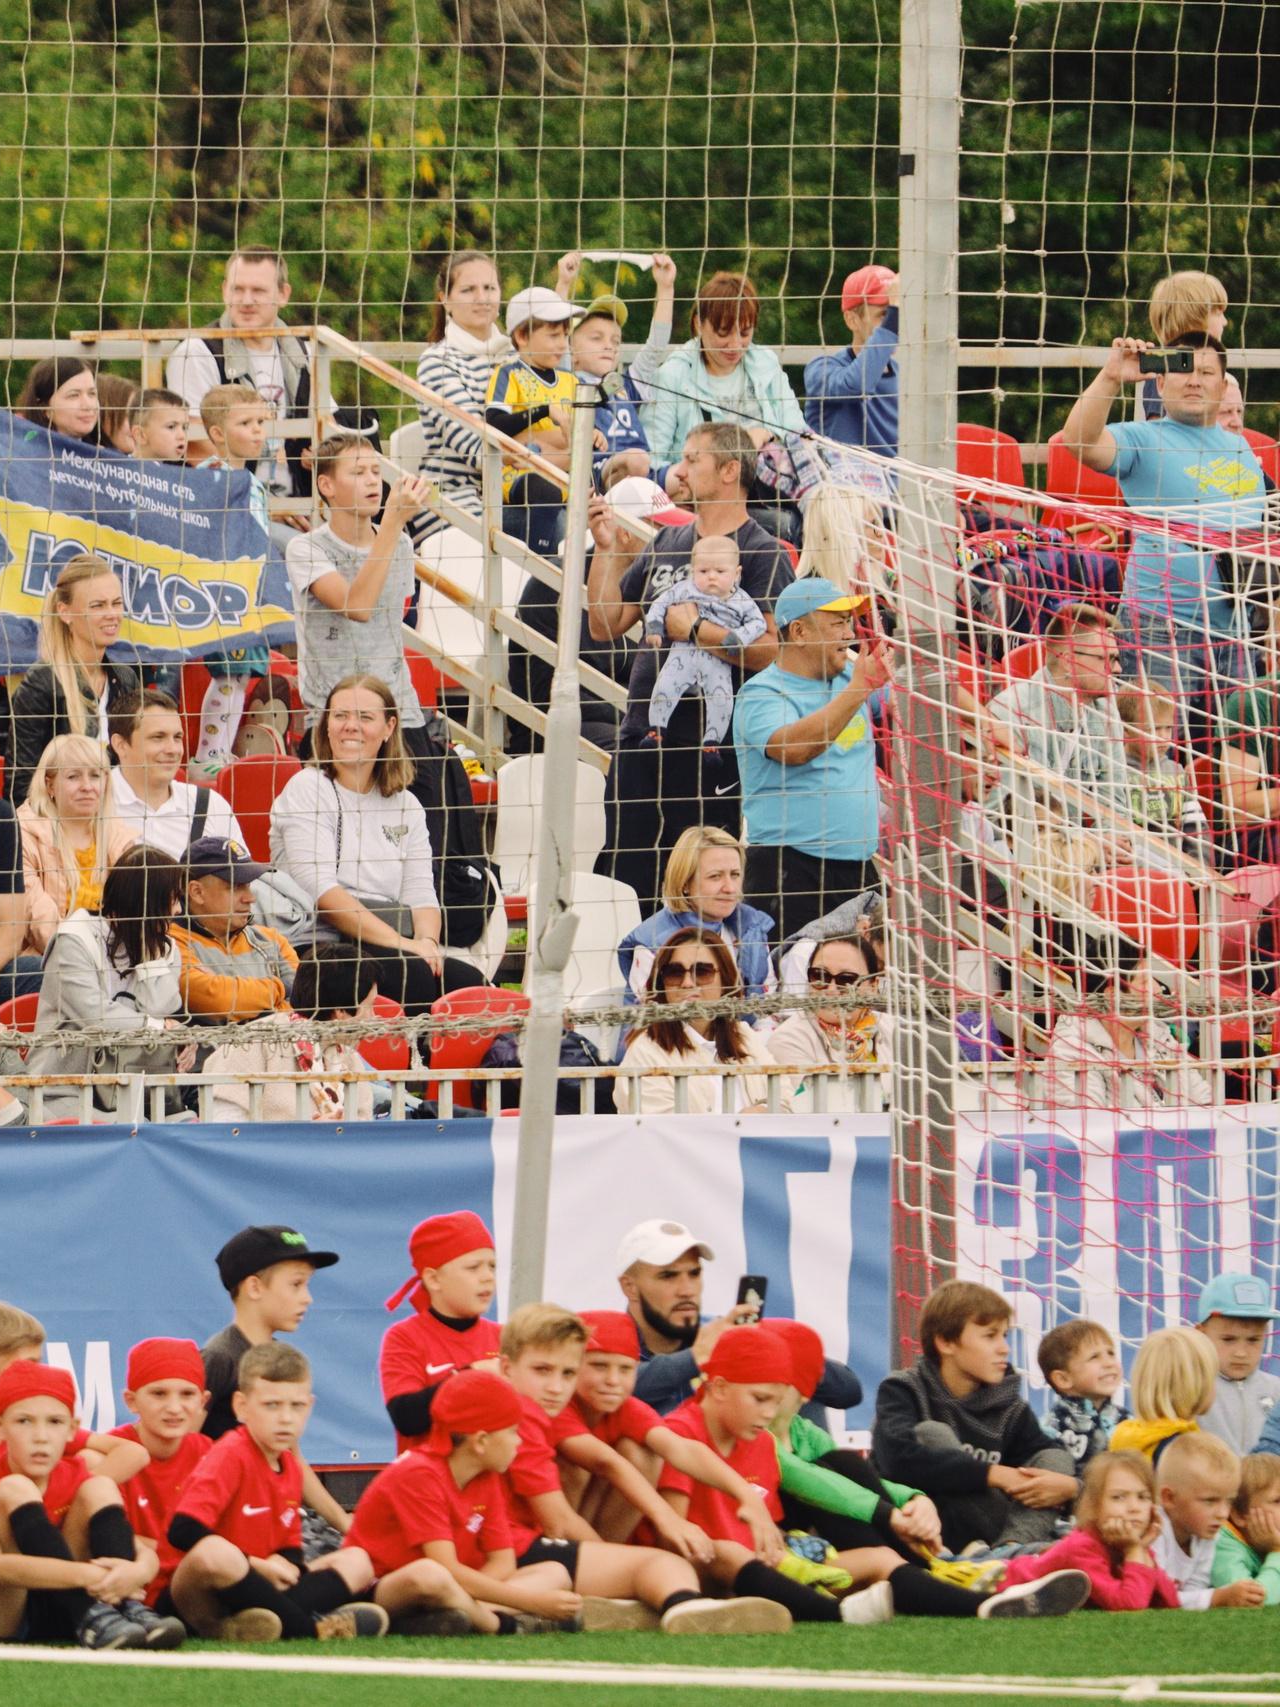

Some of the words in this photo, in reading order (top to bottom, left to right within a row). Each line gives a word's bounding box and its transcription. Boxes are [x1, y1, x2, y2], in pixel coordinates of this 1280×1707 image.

[49, 469, 104, 494] детских
[106, 483, 178, 520] футбольных
[181, 514, 211, 529] школ
[62, 448, 169, 494] Международная
[172, 483, 196, 502] сеть
